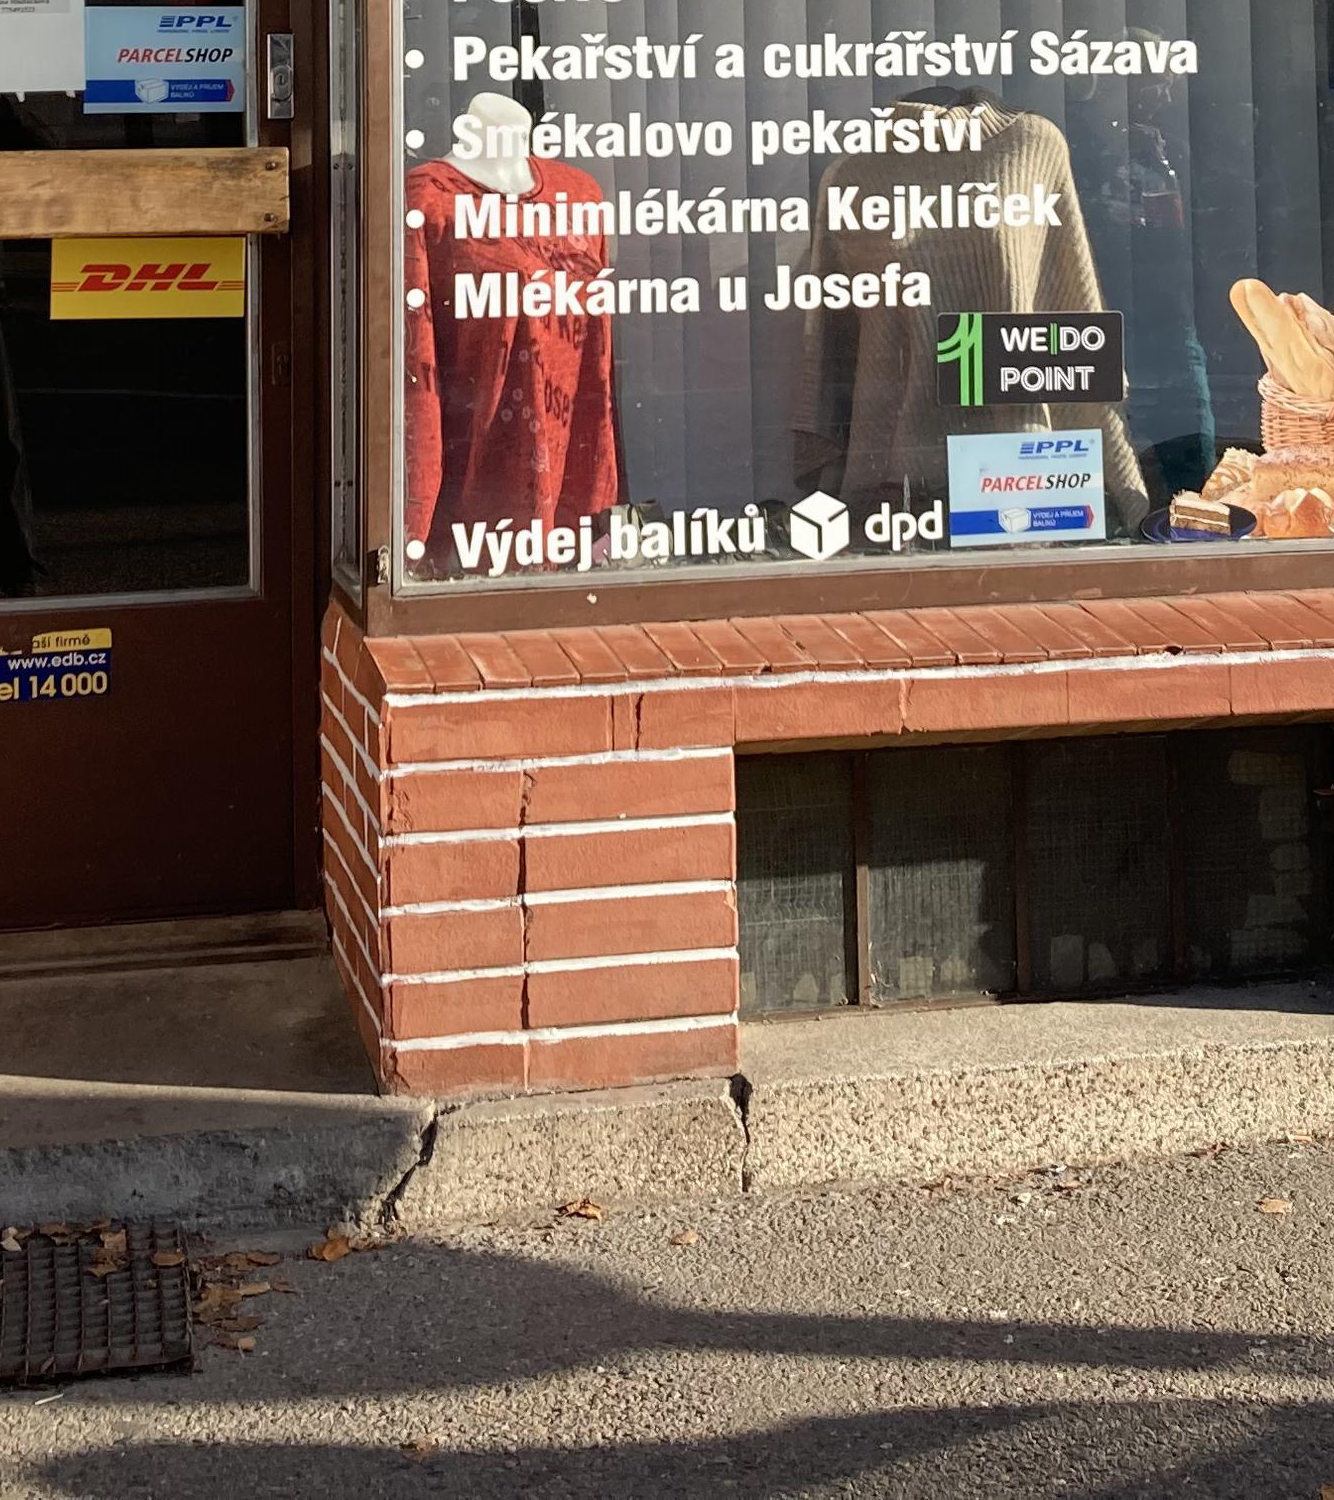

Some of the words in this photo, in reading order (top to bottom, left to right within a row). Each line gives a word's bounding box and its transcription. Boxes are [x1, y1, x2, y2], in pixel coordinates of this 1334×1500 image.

[176, 15, 232, 28] PPL
[117, 48, 233, 63] PARCELSHOP
[452, 33, 703, 83] Pekařství
[715, 45, 746, 78] a
[763, 29, 1018, 78] cukrářství
[1029, 30, 1199, 76] Sázava
[452, 110, 733, 161] Smékalovo
[751, 105, 983, 164] pekařství
[453, 187, 809, 240] Minimlékárna
[827, 181, 1062, 240] Kejklíček
[77, 263, 220, 292] DHL
[453, 269, 699, 320] Mlékárna
[719, 280, 746, 312] u
[765, 265, 932, 311] Josefa
[1000, 366, 1095, 392] POINT
[1036, 440, 1089, 454] PPL
[981, 473, 1091, 492] PARCELSHOP
[452, 514, 594, 571] Výdej
[610, 506, 767, 562] balíků
[864, 500, 944, 555] dpd
[7, 652, 107, 671] www.edb.cz
